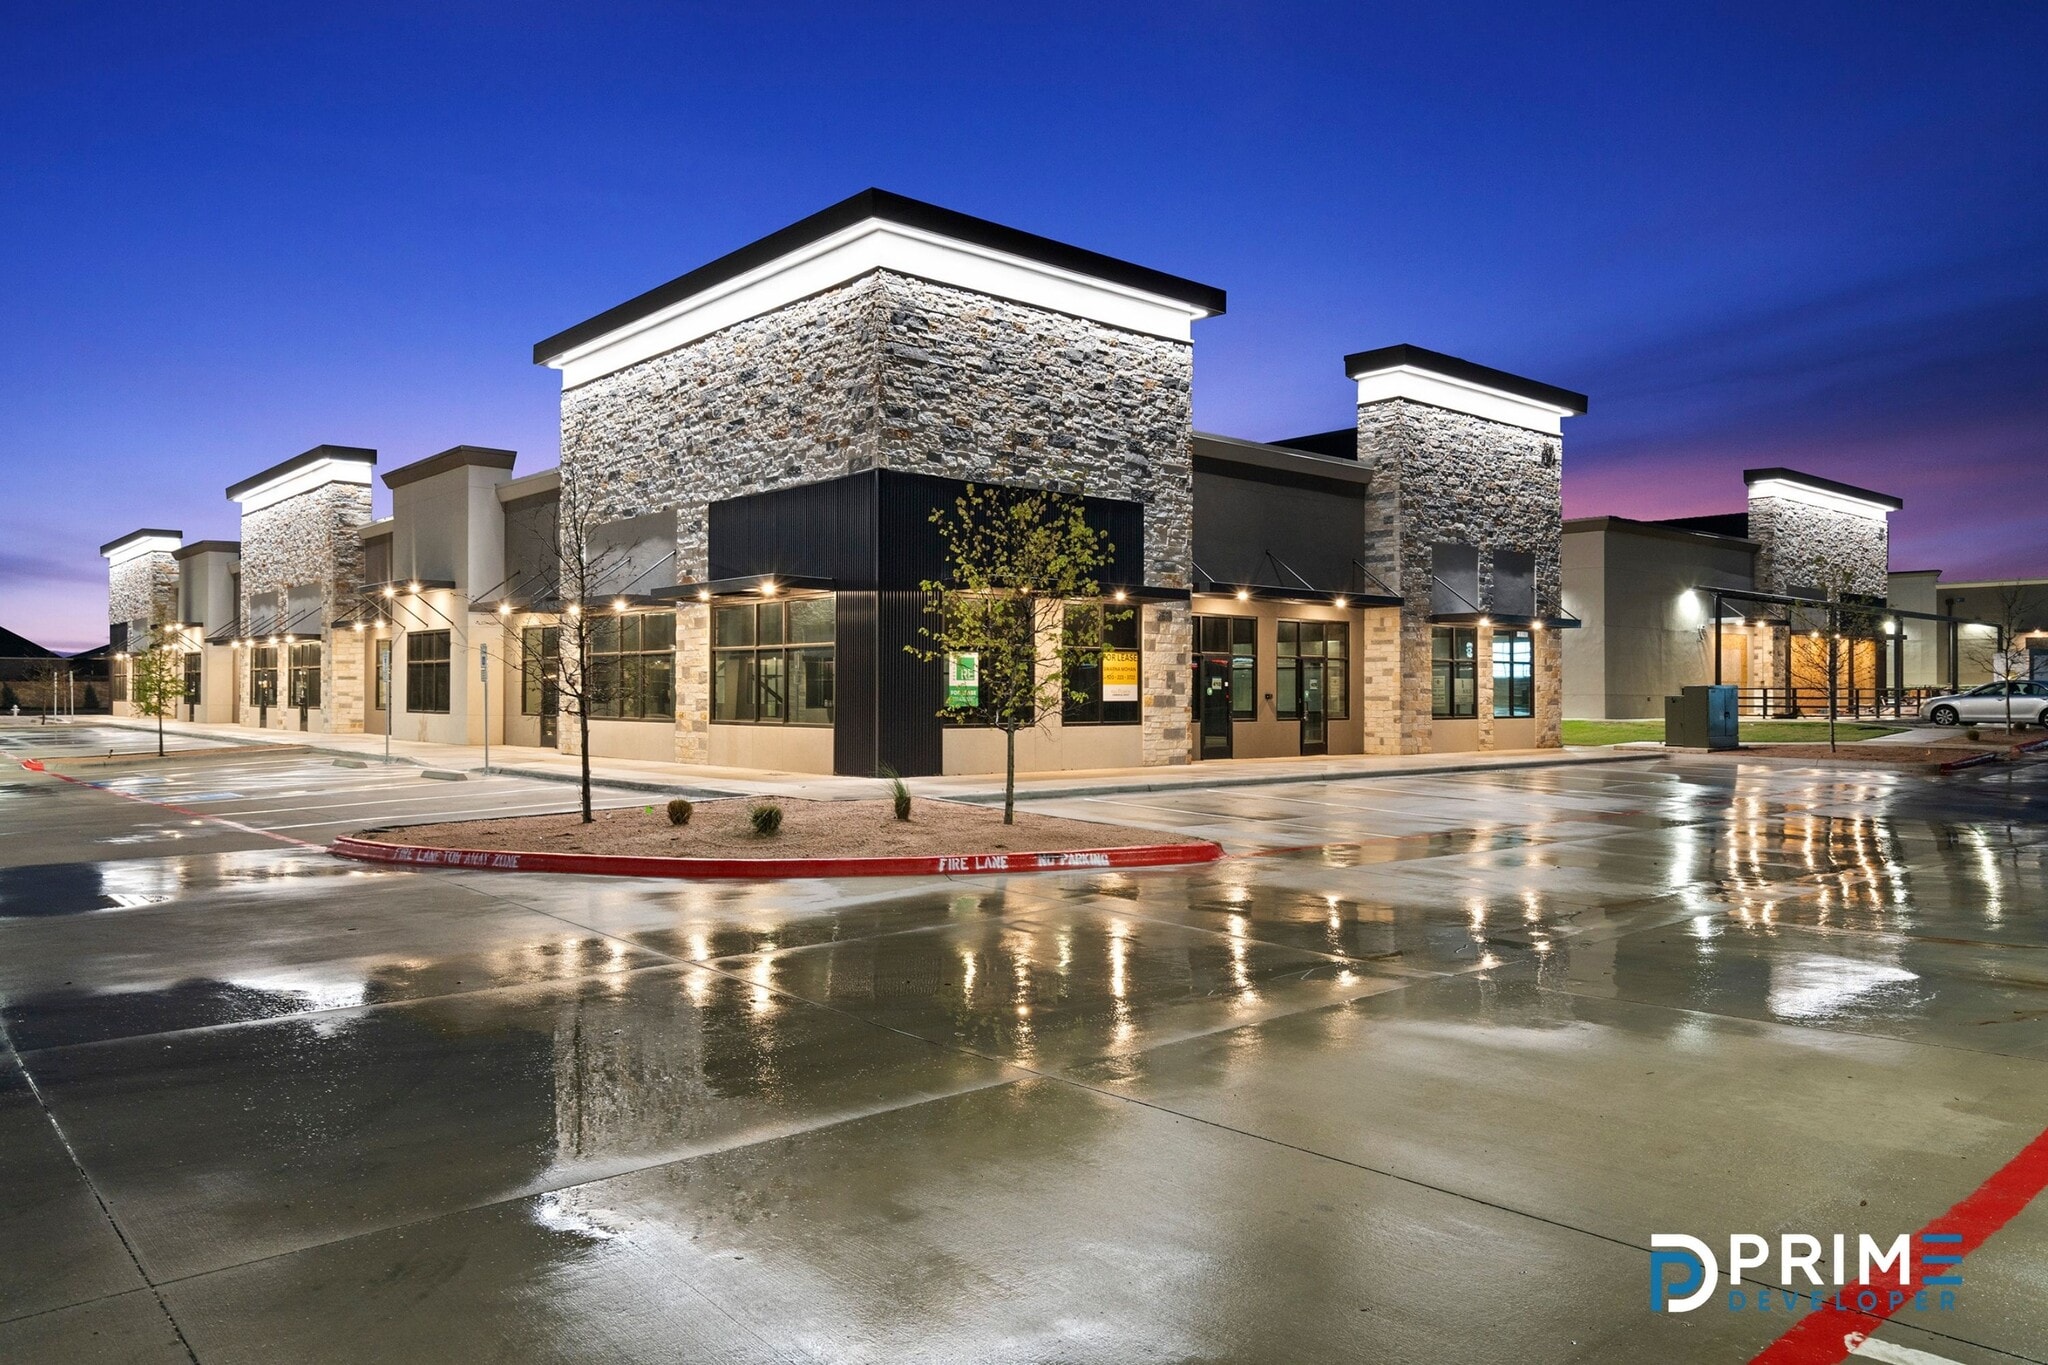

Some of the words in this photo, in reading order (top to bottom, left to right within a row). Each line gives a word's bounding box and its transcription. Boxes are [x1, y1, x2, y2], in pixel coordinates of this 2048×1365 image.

[1117, 653, 1138, 662] LEASE
[394, 847, 416, 860] FIRE
[416, 850, 441, 862] LANE
[491, 854, 521, 868] ZONE
[938, 857, 969, 872] FIRE
[975, 856, 1009, 870] LANE
[1060, 853, 1110, 866] PARKING
